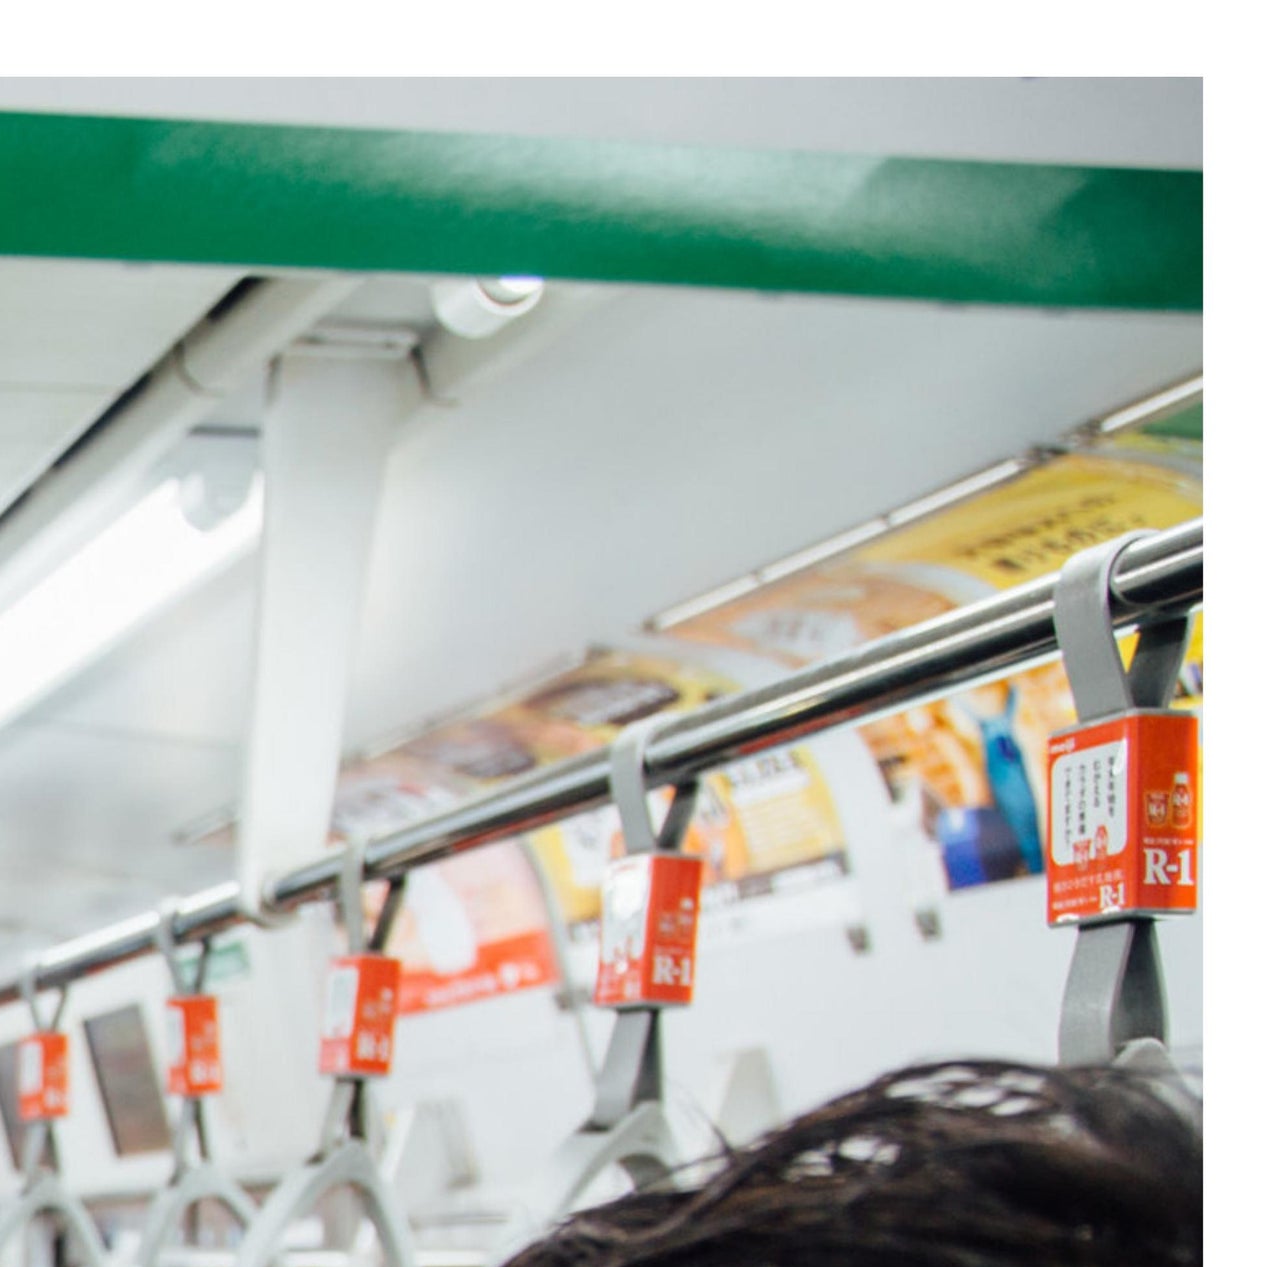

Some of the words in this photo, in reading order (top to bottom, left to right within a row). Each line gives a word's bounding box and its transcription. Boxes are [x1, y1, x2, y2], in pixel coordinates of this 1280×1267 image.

[1143, 848, 1193, 885] R-1
[1100, 882, 1124, 909] R-1
[651, 954, 691, 985] R-1
